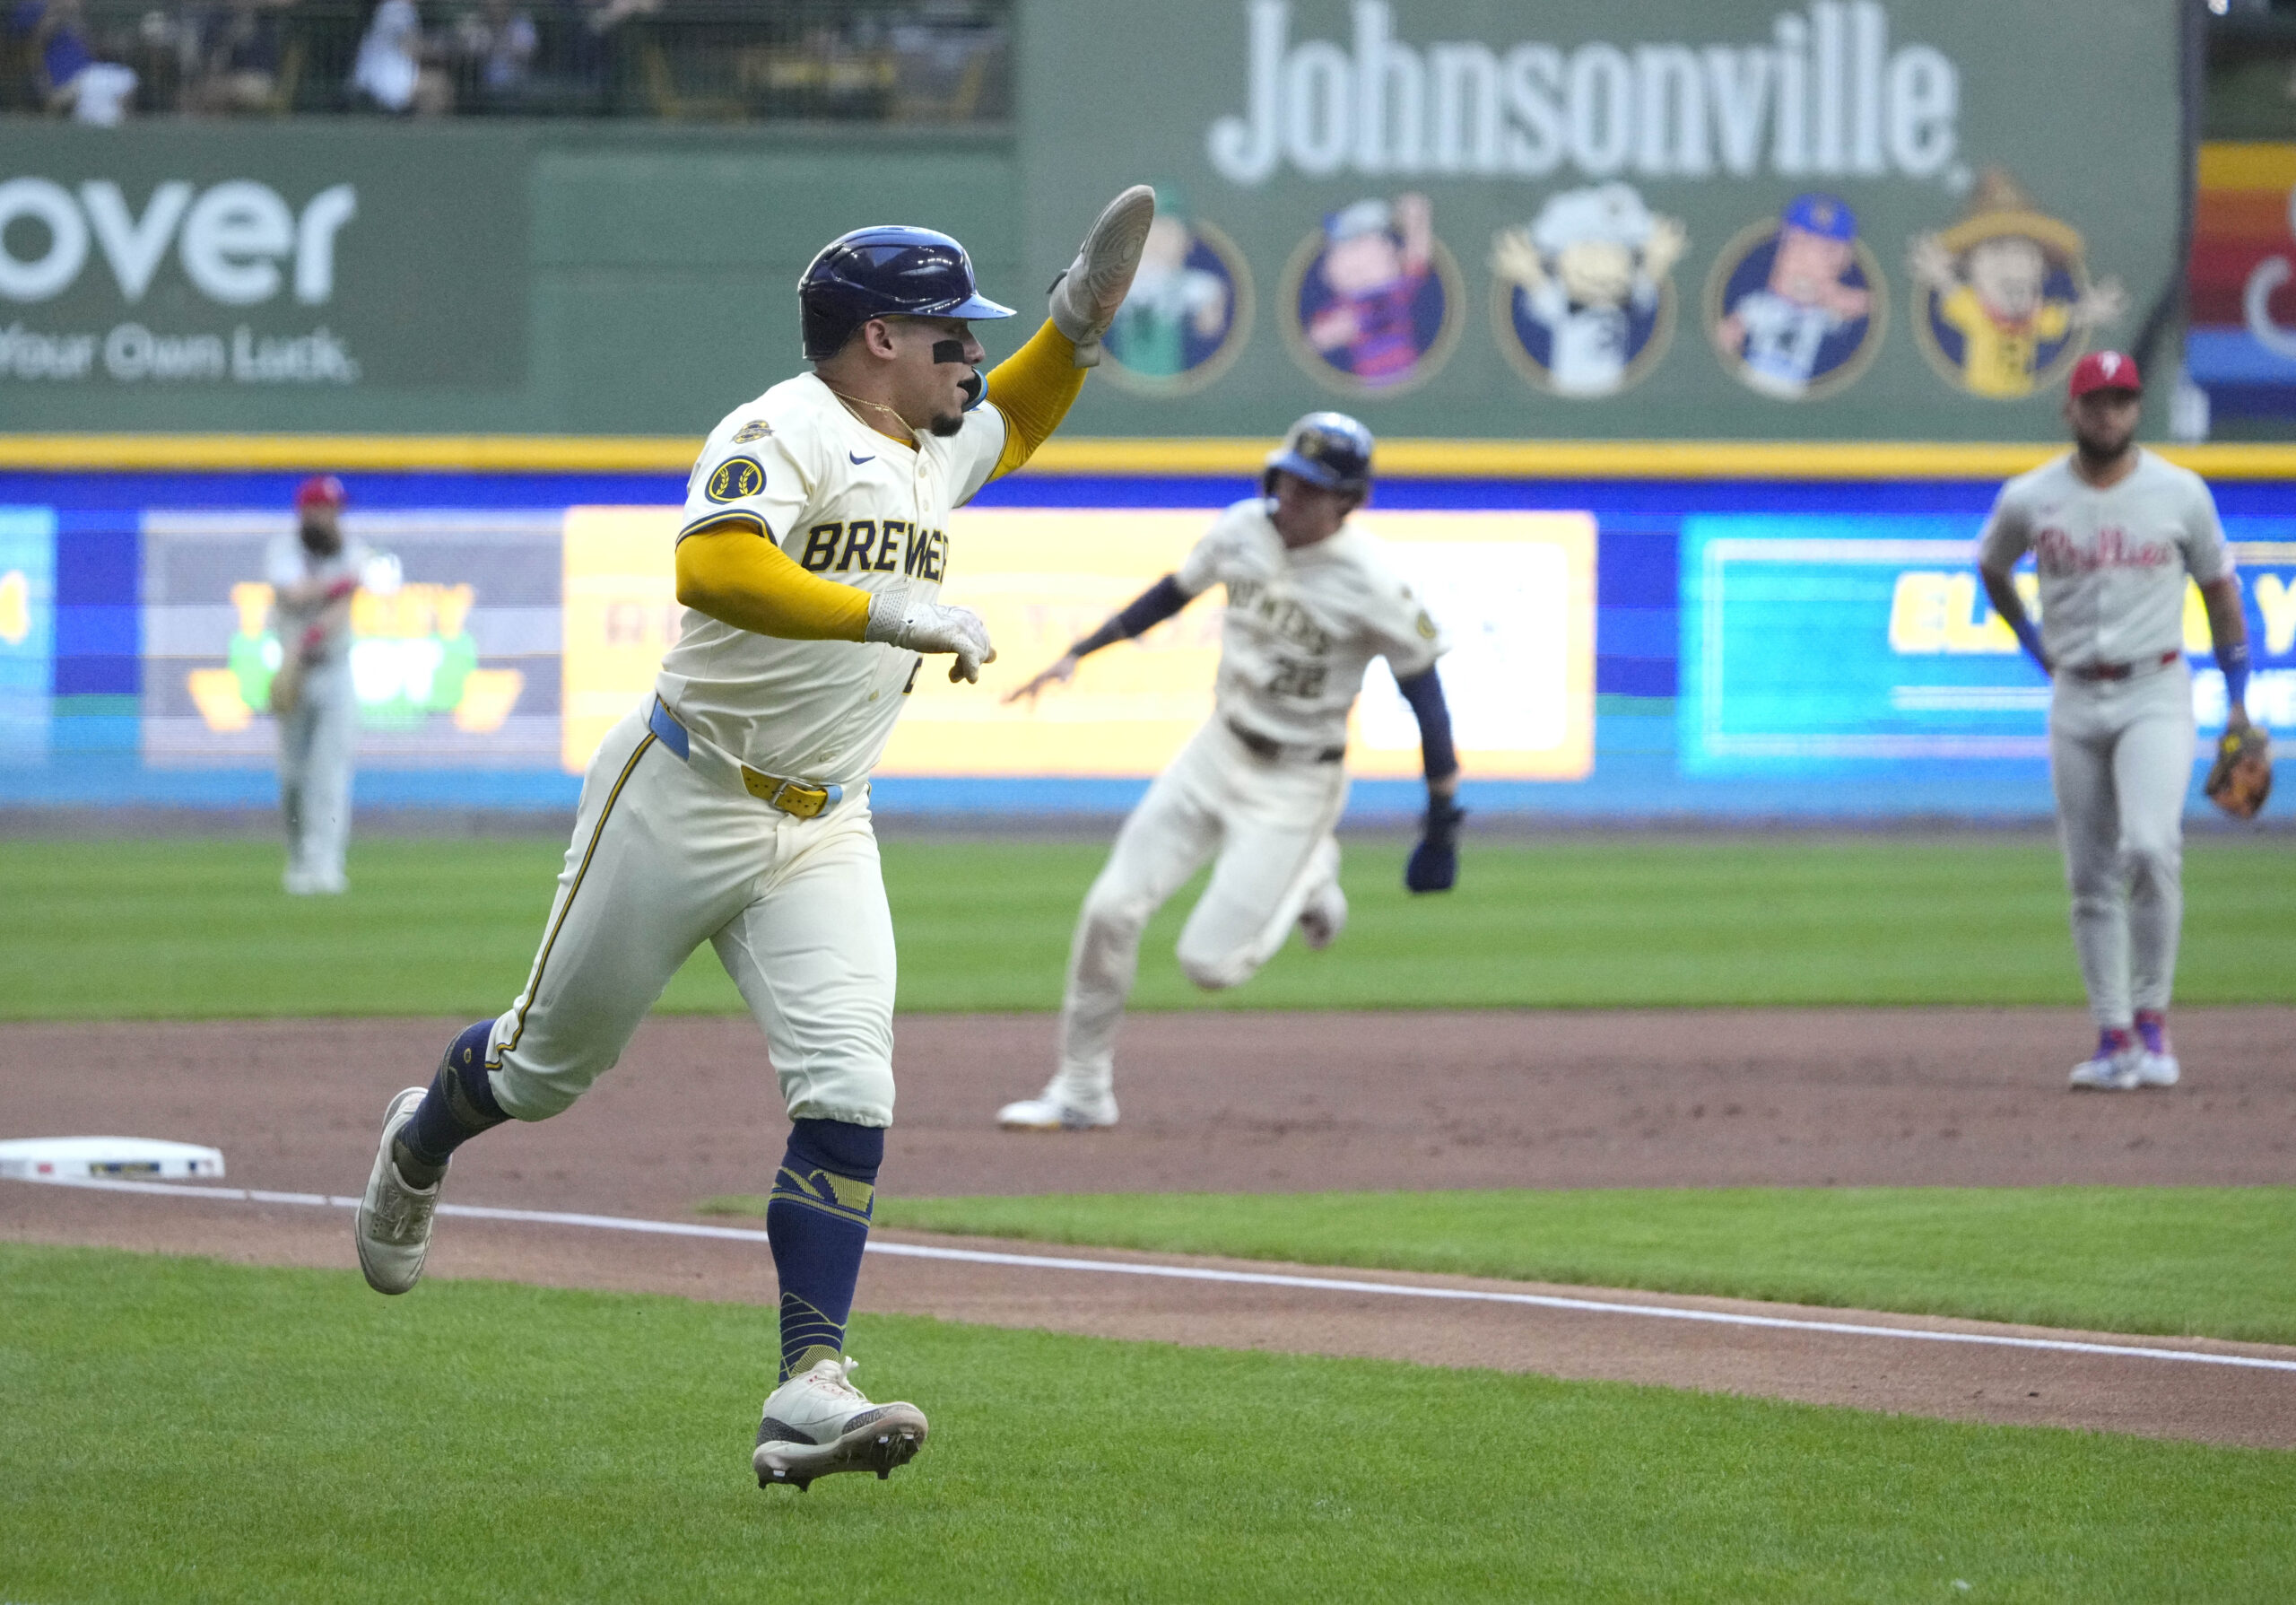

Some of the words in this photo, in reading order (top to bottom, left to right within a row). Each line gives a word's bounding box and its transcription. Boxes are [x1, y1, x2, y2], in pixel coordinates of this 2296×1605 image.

[1208, 0, 1961, 185] Johnsonville
[0, 178, 357, 304] over
[104, 321, 225, 382] Own
